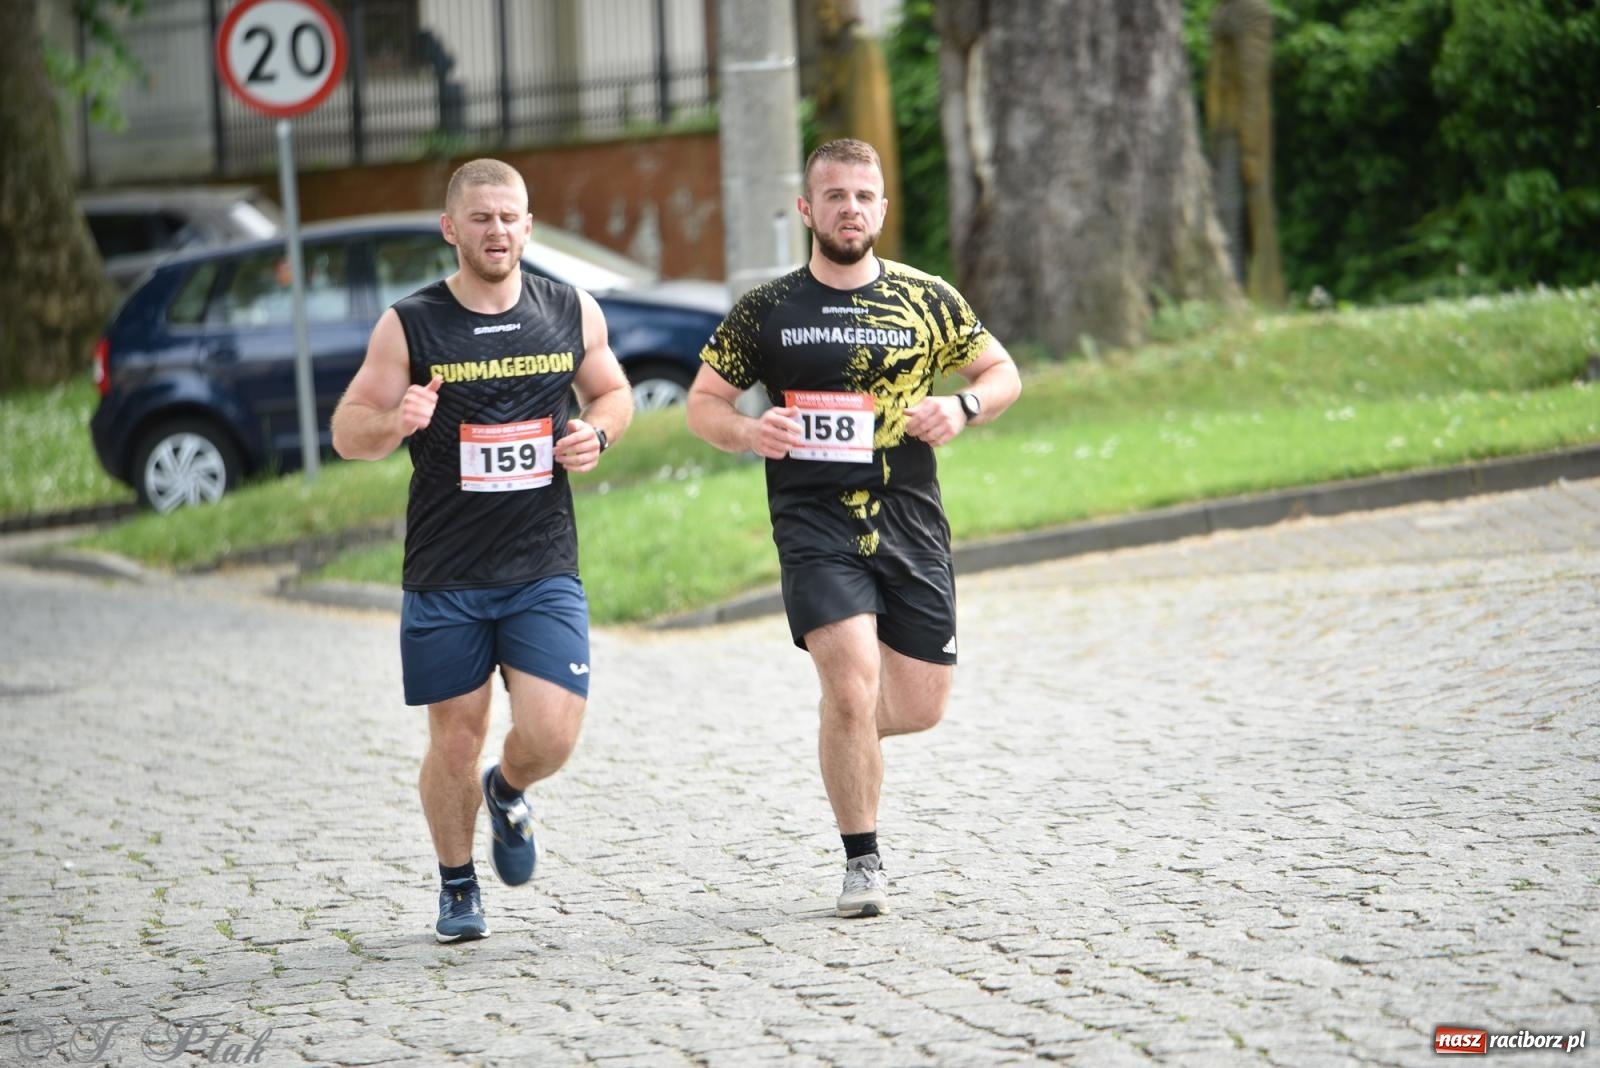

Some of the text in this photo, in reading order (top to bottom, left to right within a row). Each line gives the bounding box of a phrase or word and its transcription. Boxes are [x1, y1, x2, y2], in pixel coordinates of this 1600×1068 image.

[243, 22, 326, 83] 20
[781, 326, 912, 347] RUNMAGEDDON
[430, 352, 574, 383] RUNMAGEDDON
[801, 415, 855, 441] 158
[480, 443, 537, 474] 159
